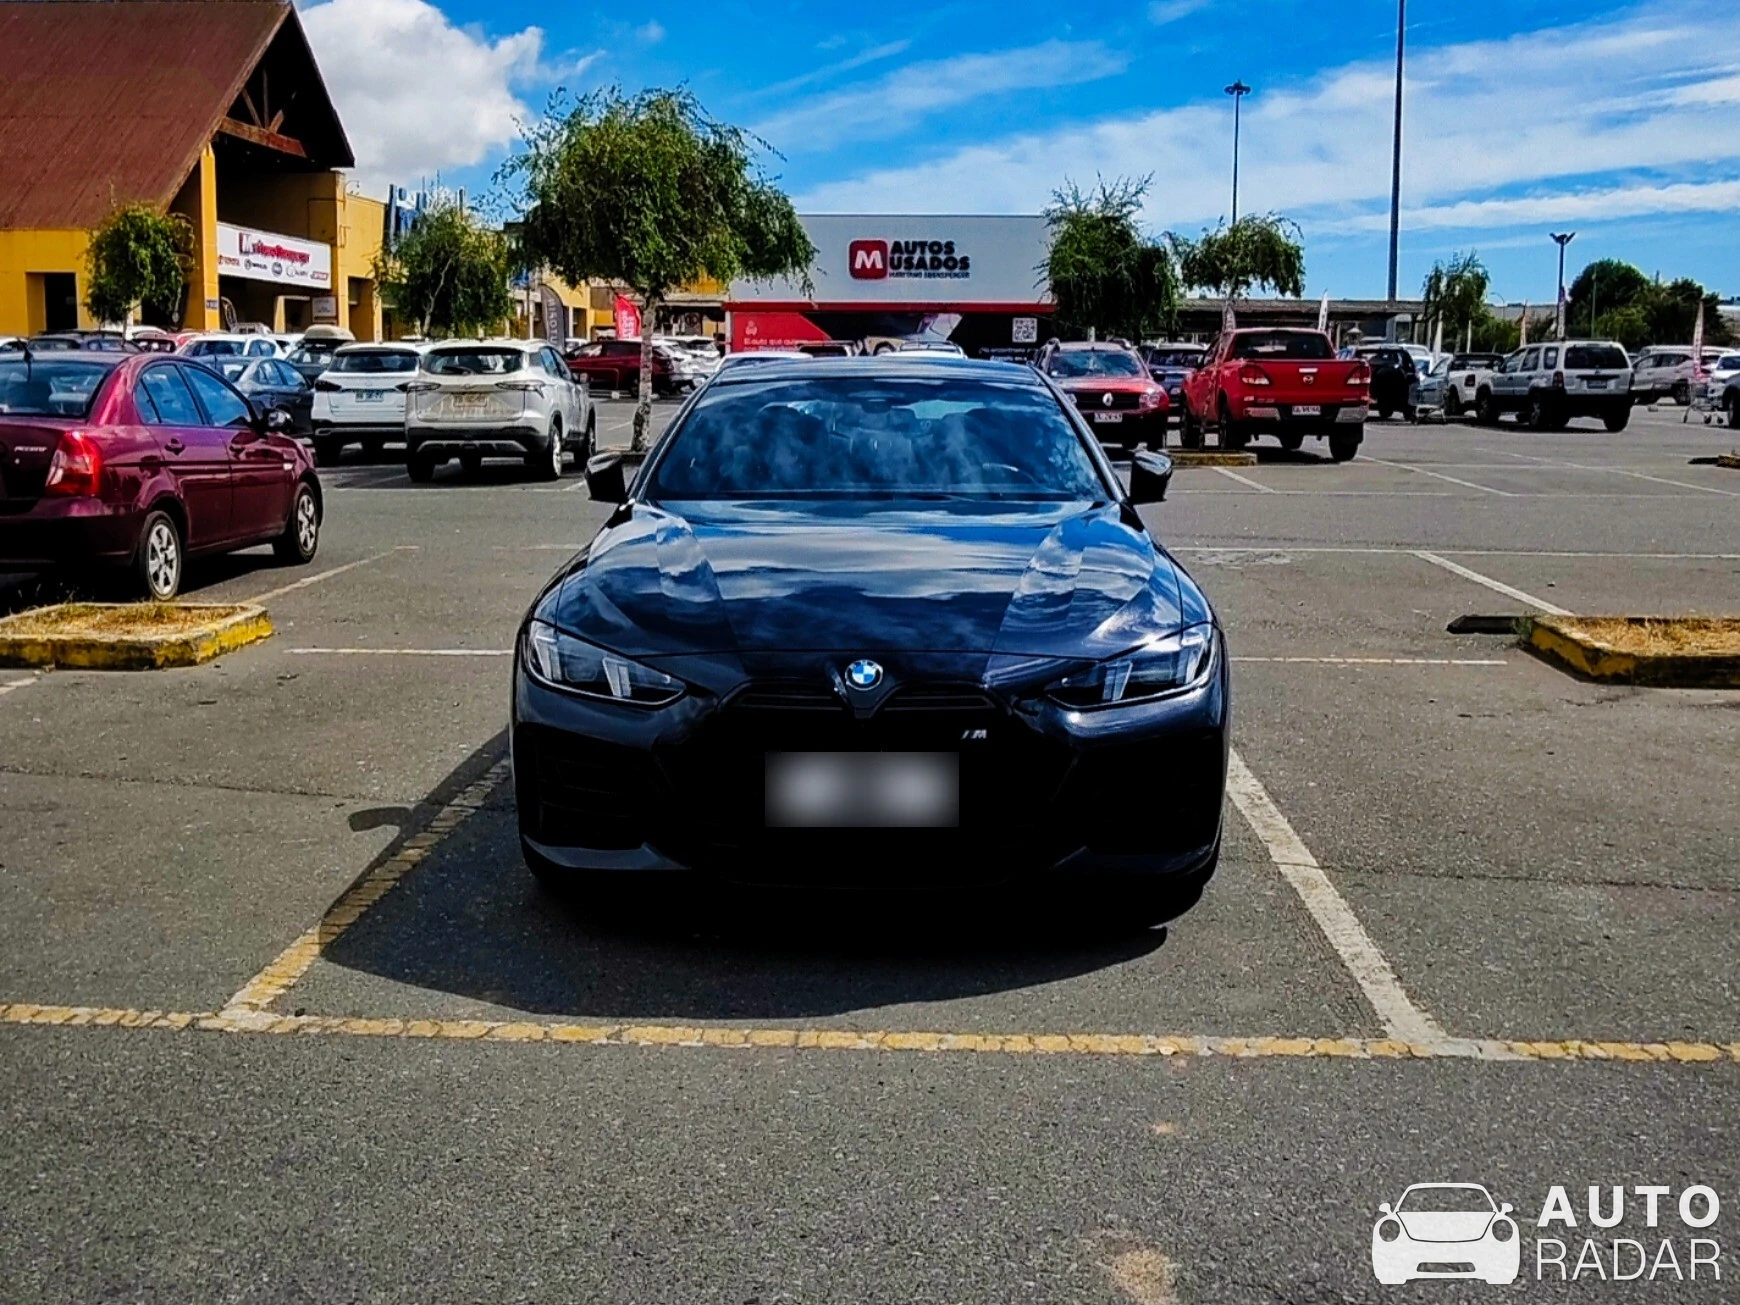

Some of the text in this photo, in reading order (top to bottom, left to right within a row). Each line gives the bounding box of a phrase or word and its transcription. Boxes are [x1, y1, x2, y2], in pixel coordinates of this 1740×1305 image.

[890, 240, 956, 255] AUTOS
[854, 250, 884, 269] M
[889, 256, 971, 270] USADOS
